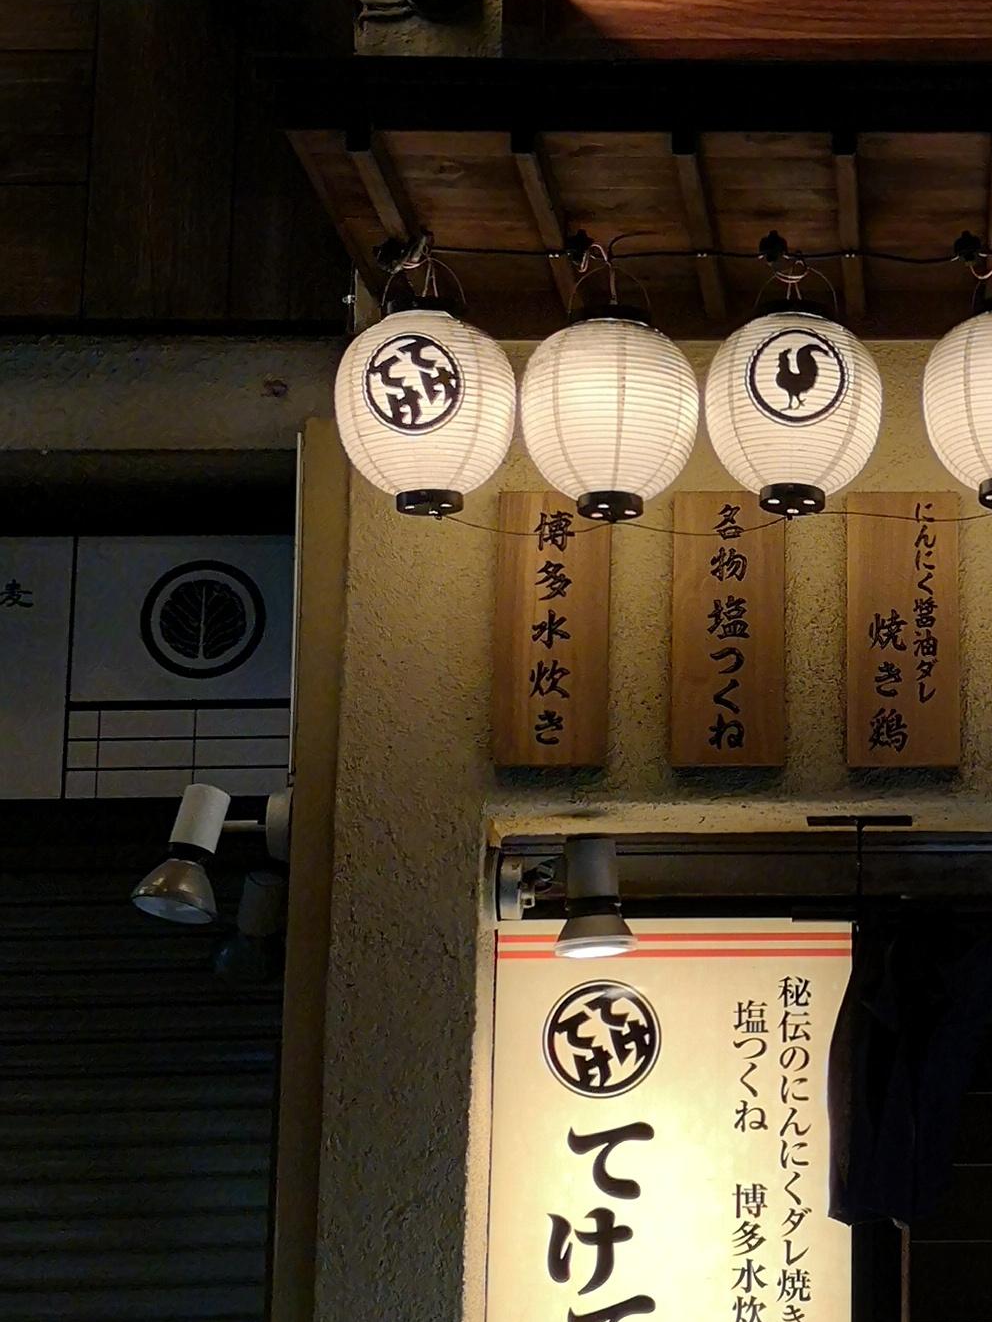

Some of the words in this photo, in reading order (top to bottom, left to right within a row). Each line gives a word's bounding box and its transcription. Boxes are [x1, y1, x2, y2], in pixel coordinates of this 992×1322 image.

[528, 510, 576, 745] 博多水炊き
[868, 609, 909, 754] 焼き鶏
[913, 502, 939, 704] にんにく醤油ダレ
[732, 999, 769, 1133] 塩つくね
